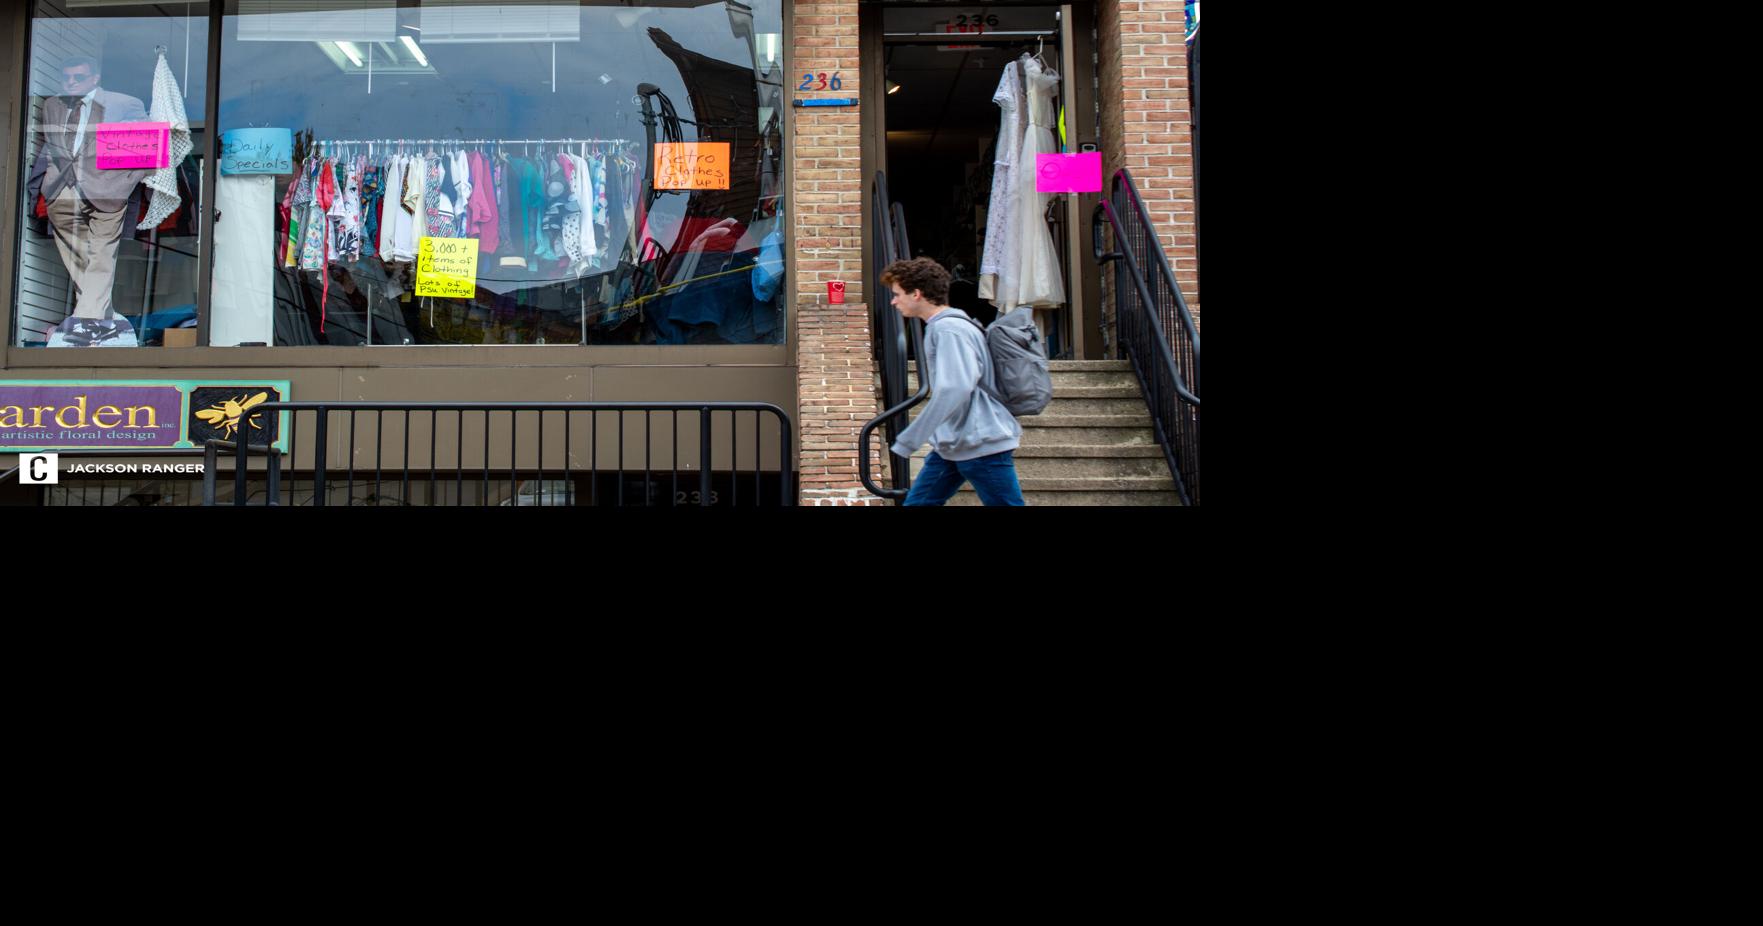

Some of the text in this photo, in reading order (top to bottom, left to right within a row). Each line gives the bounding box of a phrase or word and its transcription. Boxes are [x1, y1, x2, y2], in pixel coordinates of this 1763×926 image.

[956, 14, 999, 27] 236
[799, 71, 842, 91] 236
[229, 137, 274, 155] Daily
[660, 145, 716, 165] Retro
[223, 154, 289, 170] Specials
[665, 165, 724, 178] Clothes
[661, 175, 687, 187] Pop
[422, 255, 473, 264] items of
[421, 264, 469, 278] Clothing
[418, 277, 461, 288] Lots of
[1, 430, 156, 441] artistic floral design
